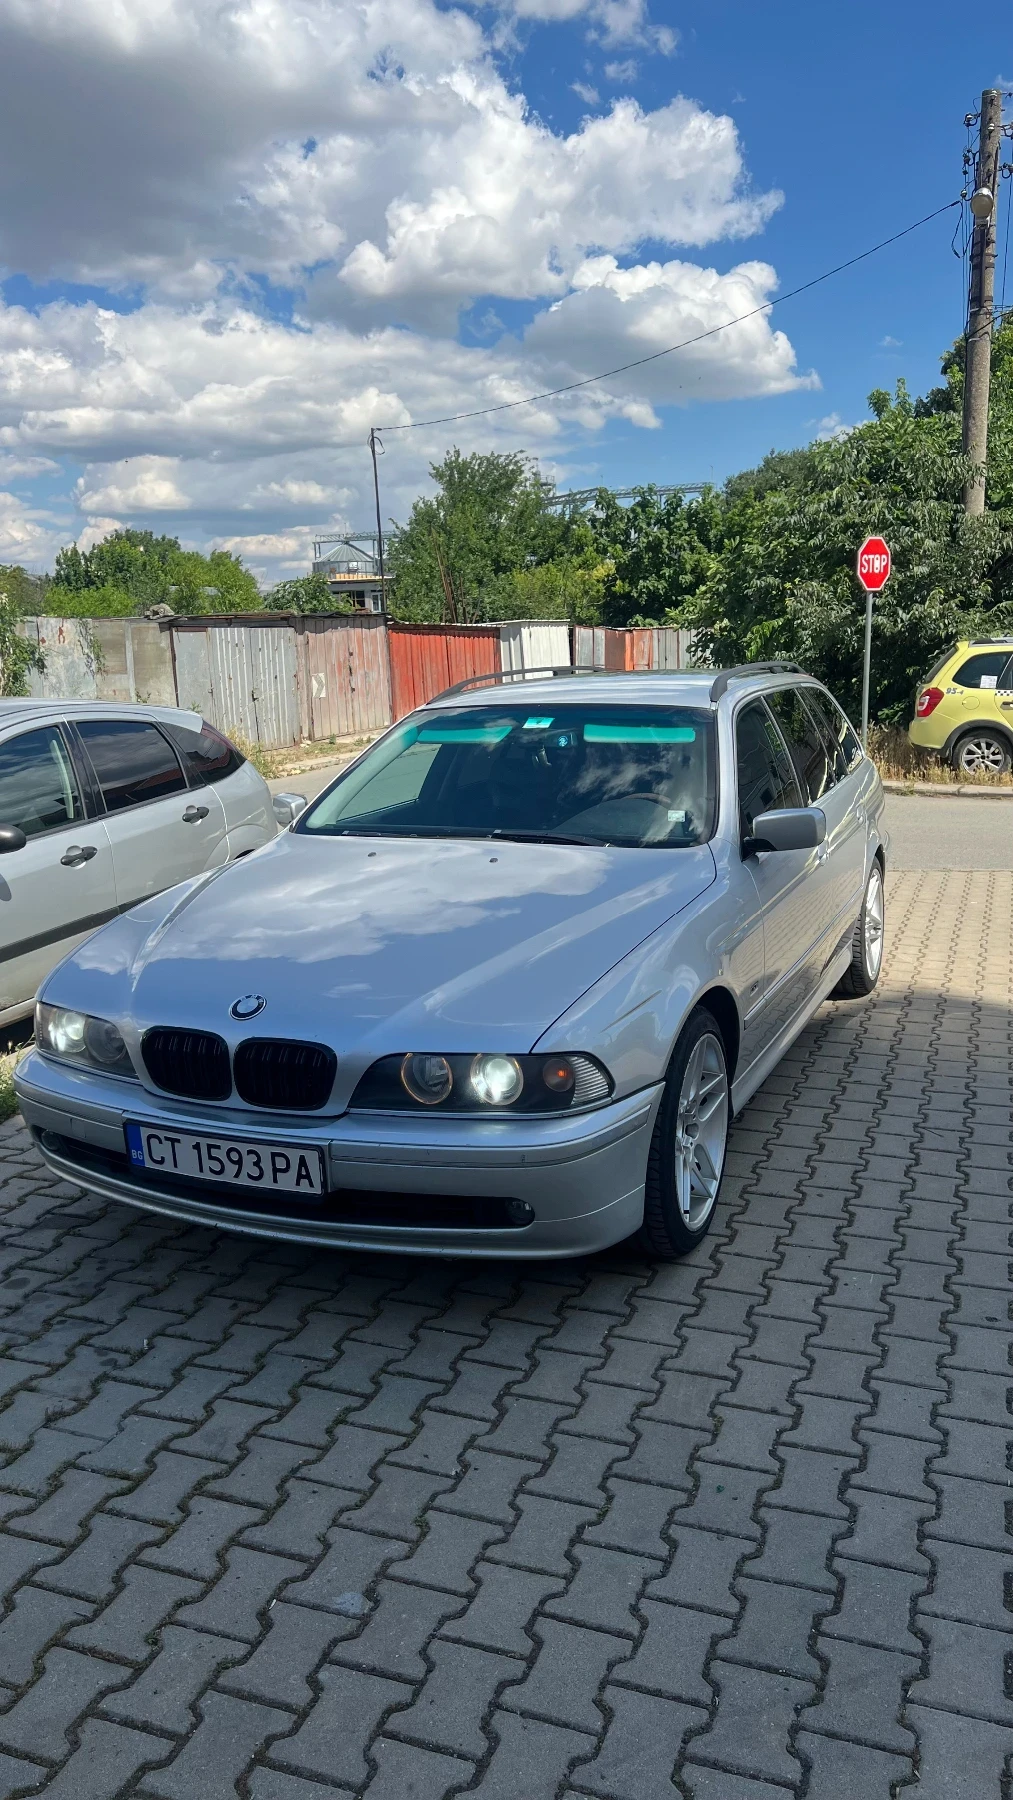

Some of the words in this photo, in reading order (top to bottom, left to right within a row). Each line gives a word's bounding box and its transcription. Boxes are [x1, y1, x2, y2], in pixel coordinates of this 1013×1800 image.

[861, 554, 888, 574] STOP
[131, 1149, 144, 1160] BG
[146, 1133, 181, 1168] CT
[191, 1141, 264, 1181] 1593
[270, 1151, 315, 1188] PA
